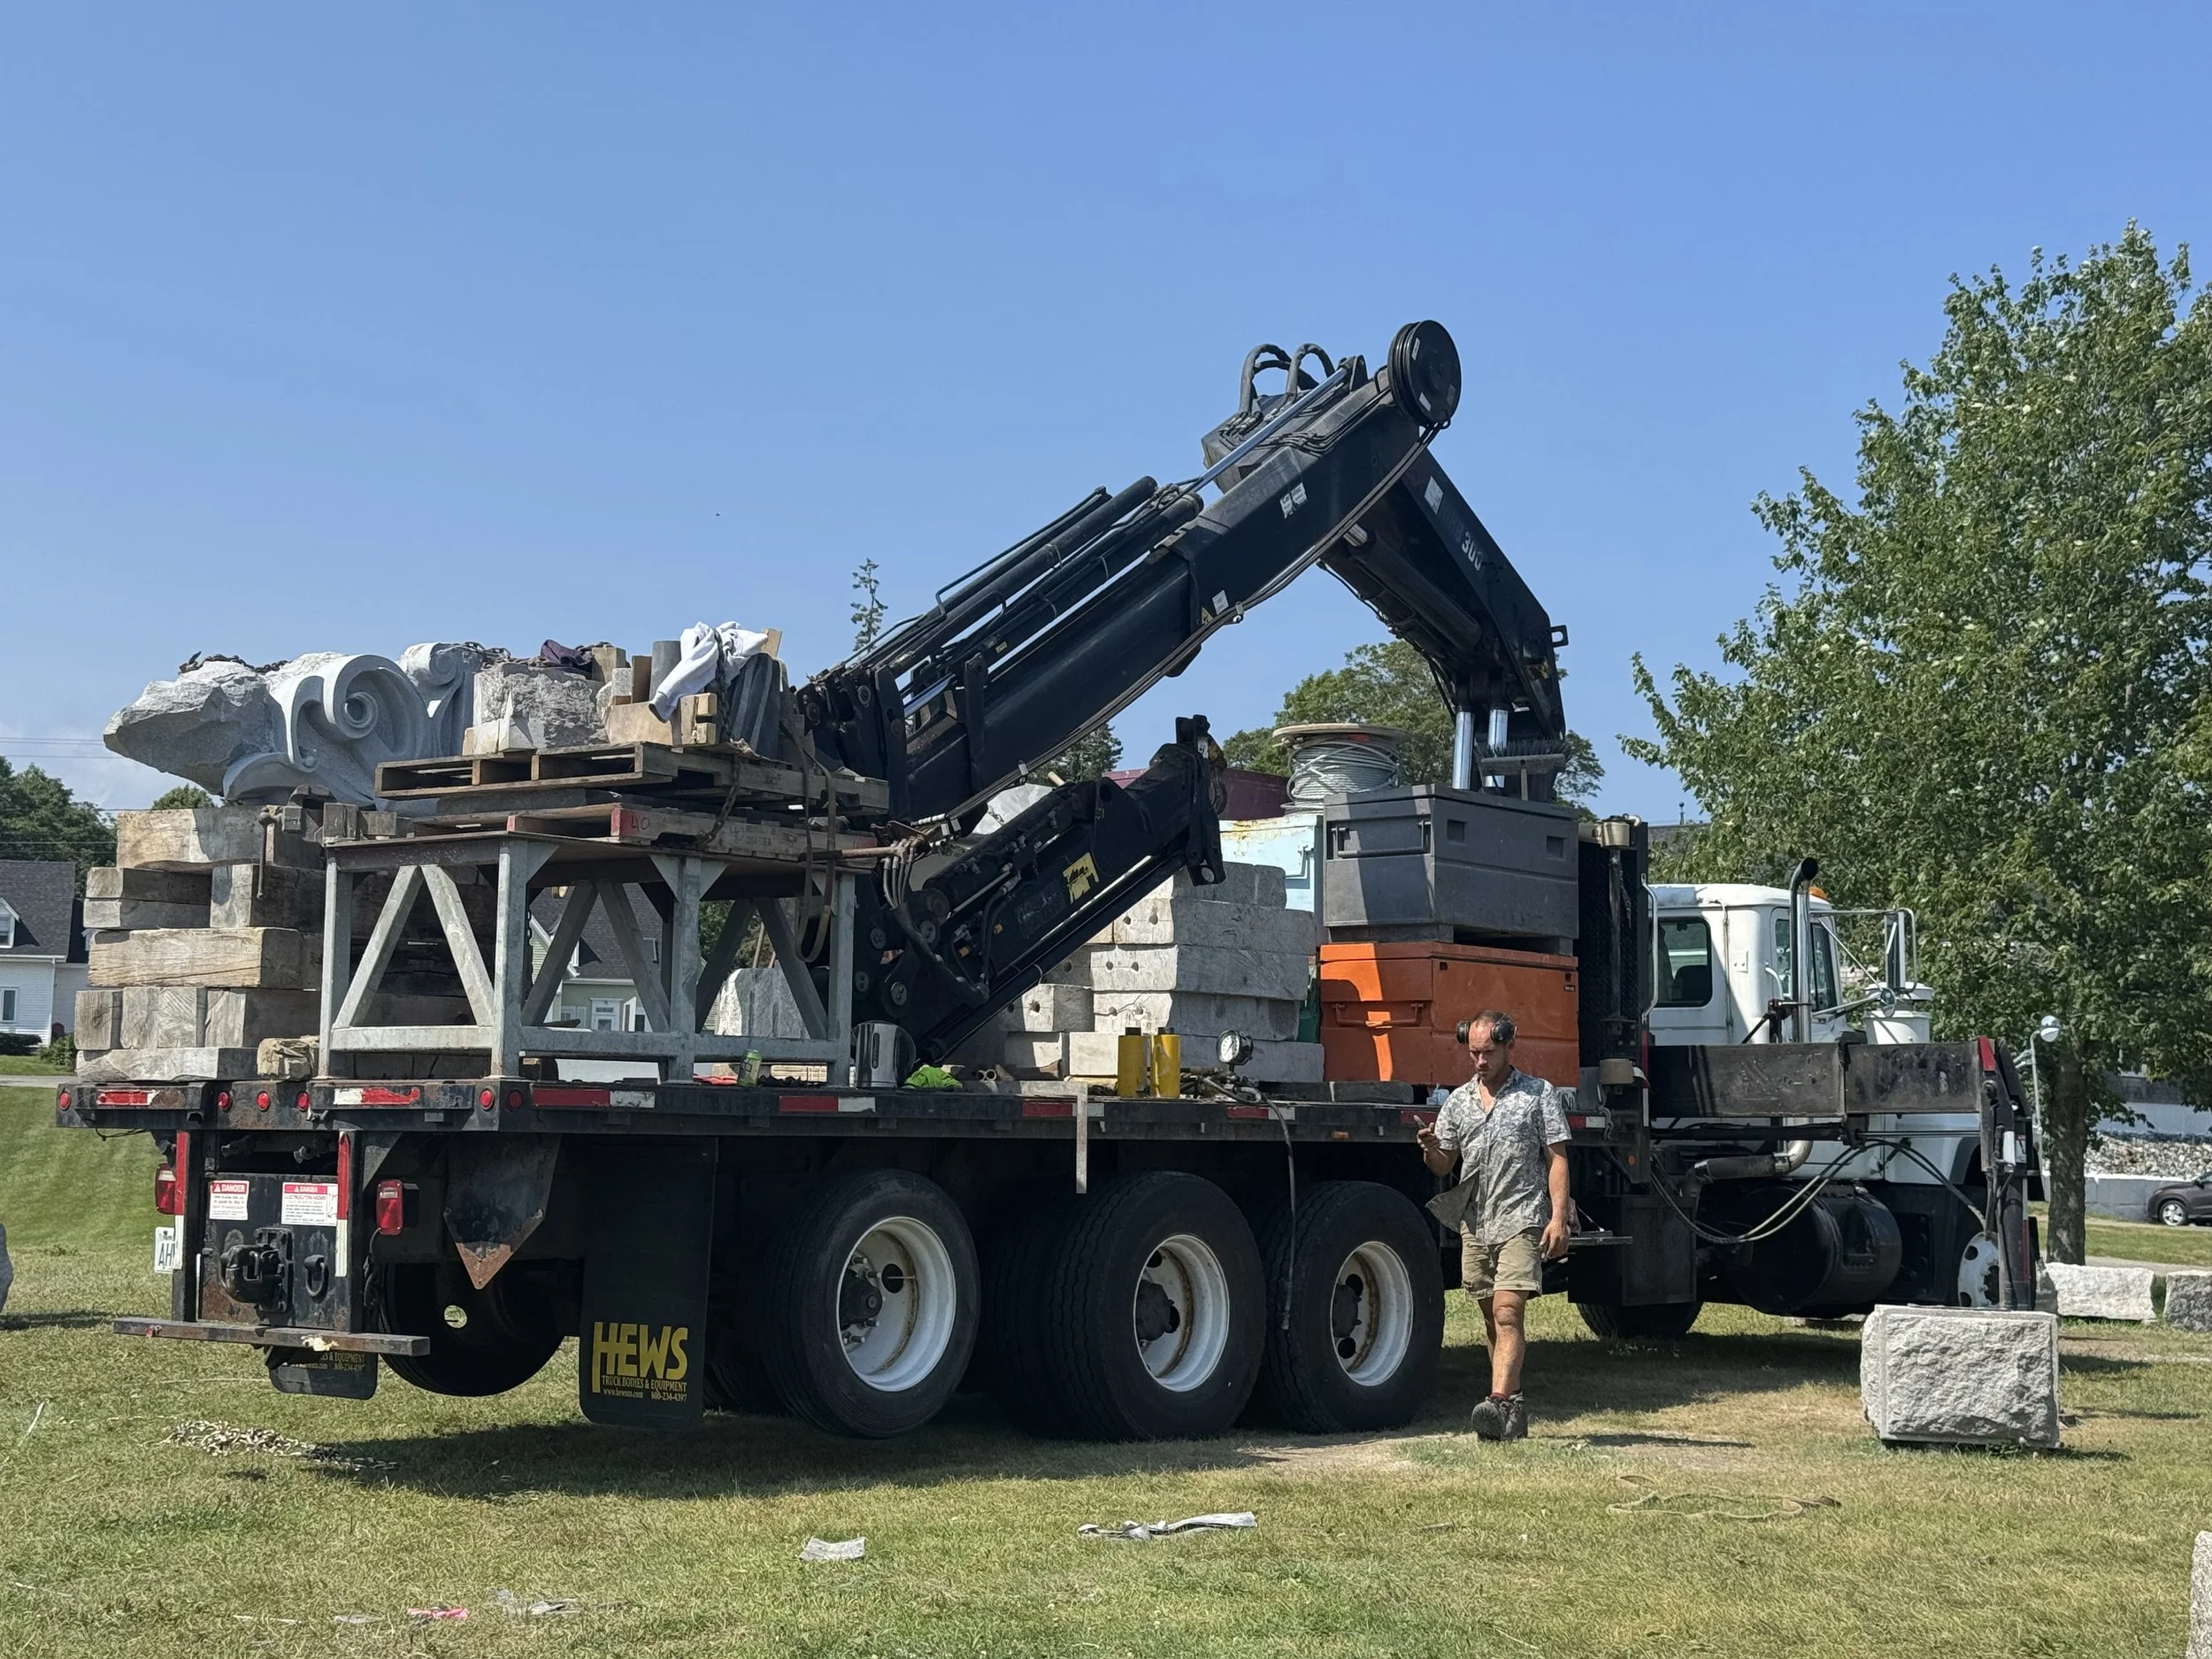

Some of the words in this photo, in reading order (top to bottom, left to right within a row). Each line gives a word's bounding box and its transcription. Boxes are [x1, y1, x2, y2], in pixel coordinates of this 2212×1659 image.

[631, 815, 650, 832] 40
[221, 1184, 246, 1193] DANGER
[592, 1321, 688, 1393] HEWS
[602, 1375, 622, 1386] TRUCK
[622, 1377, 644, 1388] BODIES
[644, 1379, 649, 1389] &
[650, 1379, 687, 1393] EQUIPMENT
